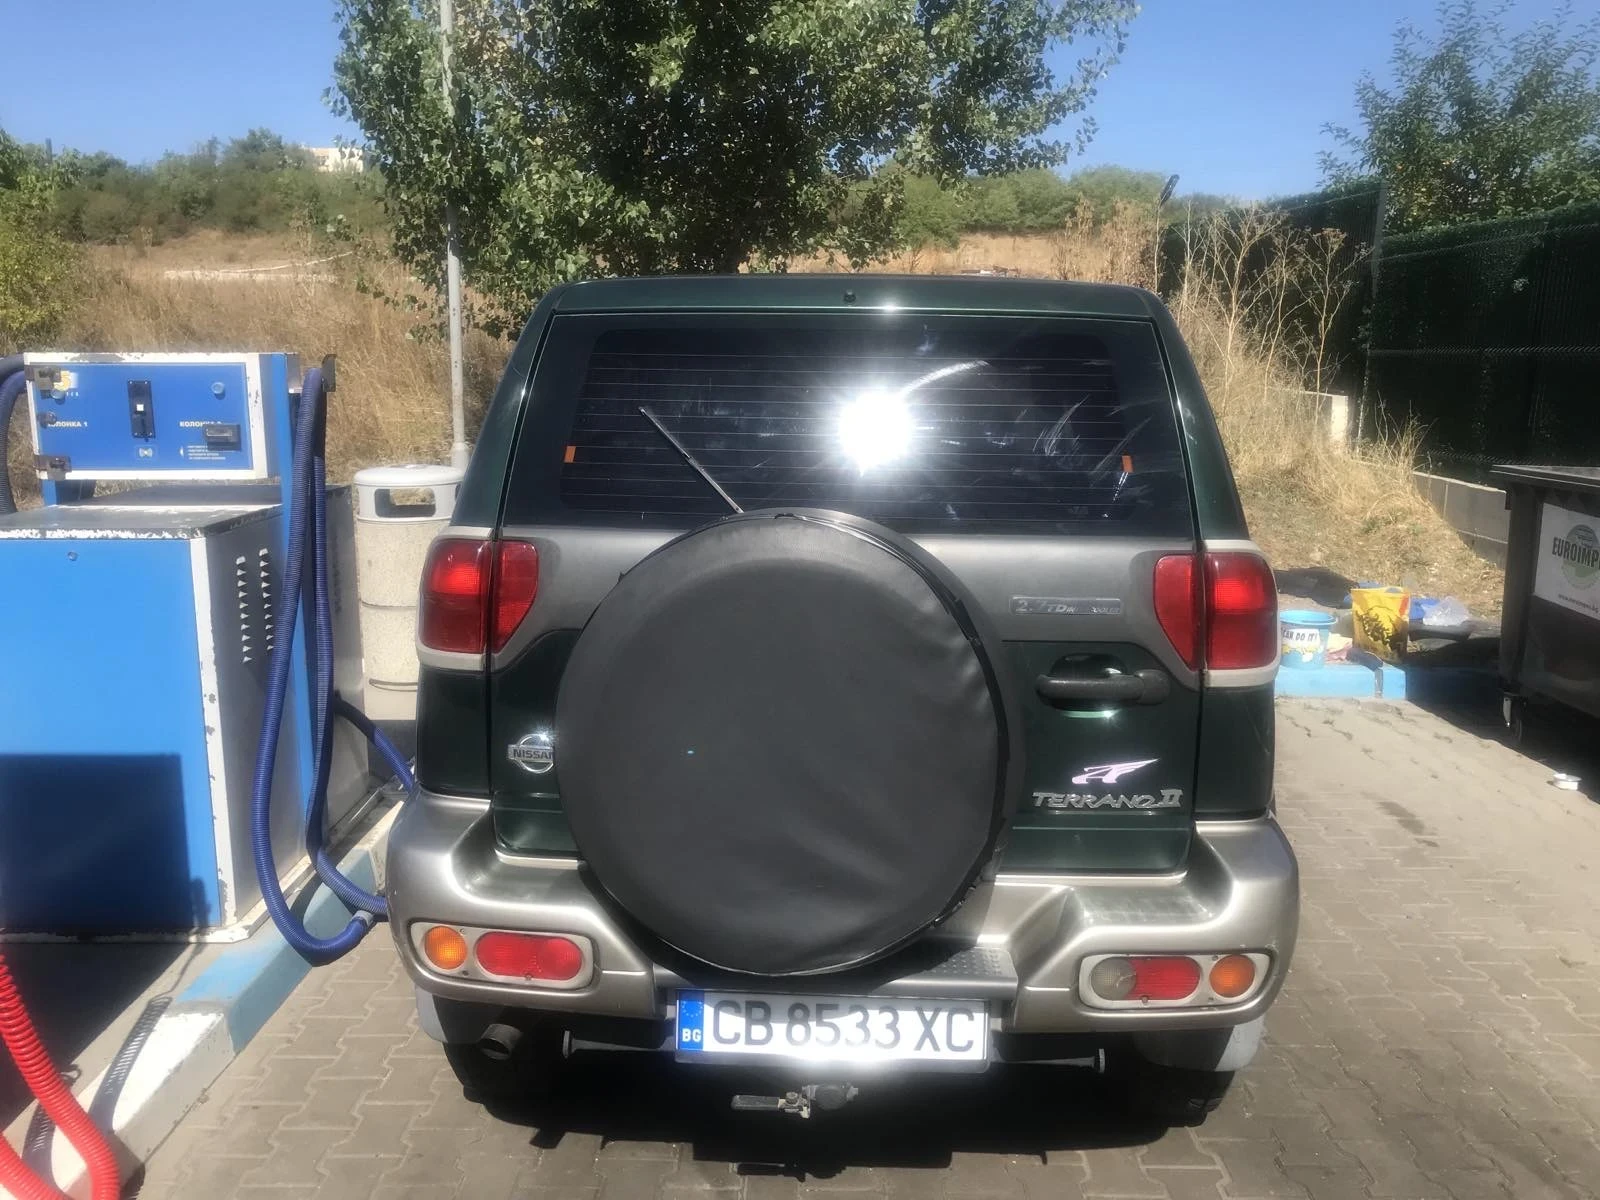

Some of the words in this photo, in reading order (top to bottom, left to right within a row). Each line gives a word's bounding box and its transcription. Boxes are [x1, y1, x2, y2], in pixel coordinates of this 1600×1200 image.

[1552, 537, 1600, 570] EUROIMP
[1032, 792, 1160, 809] TERRANO
[682, 1029, 701, 1042] BG
[713, 1000, 773, 1046] CB
[785, 1003, 901, 1050] 8533
[913, 1006, 975, 1052] XC
